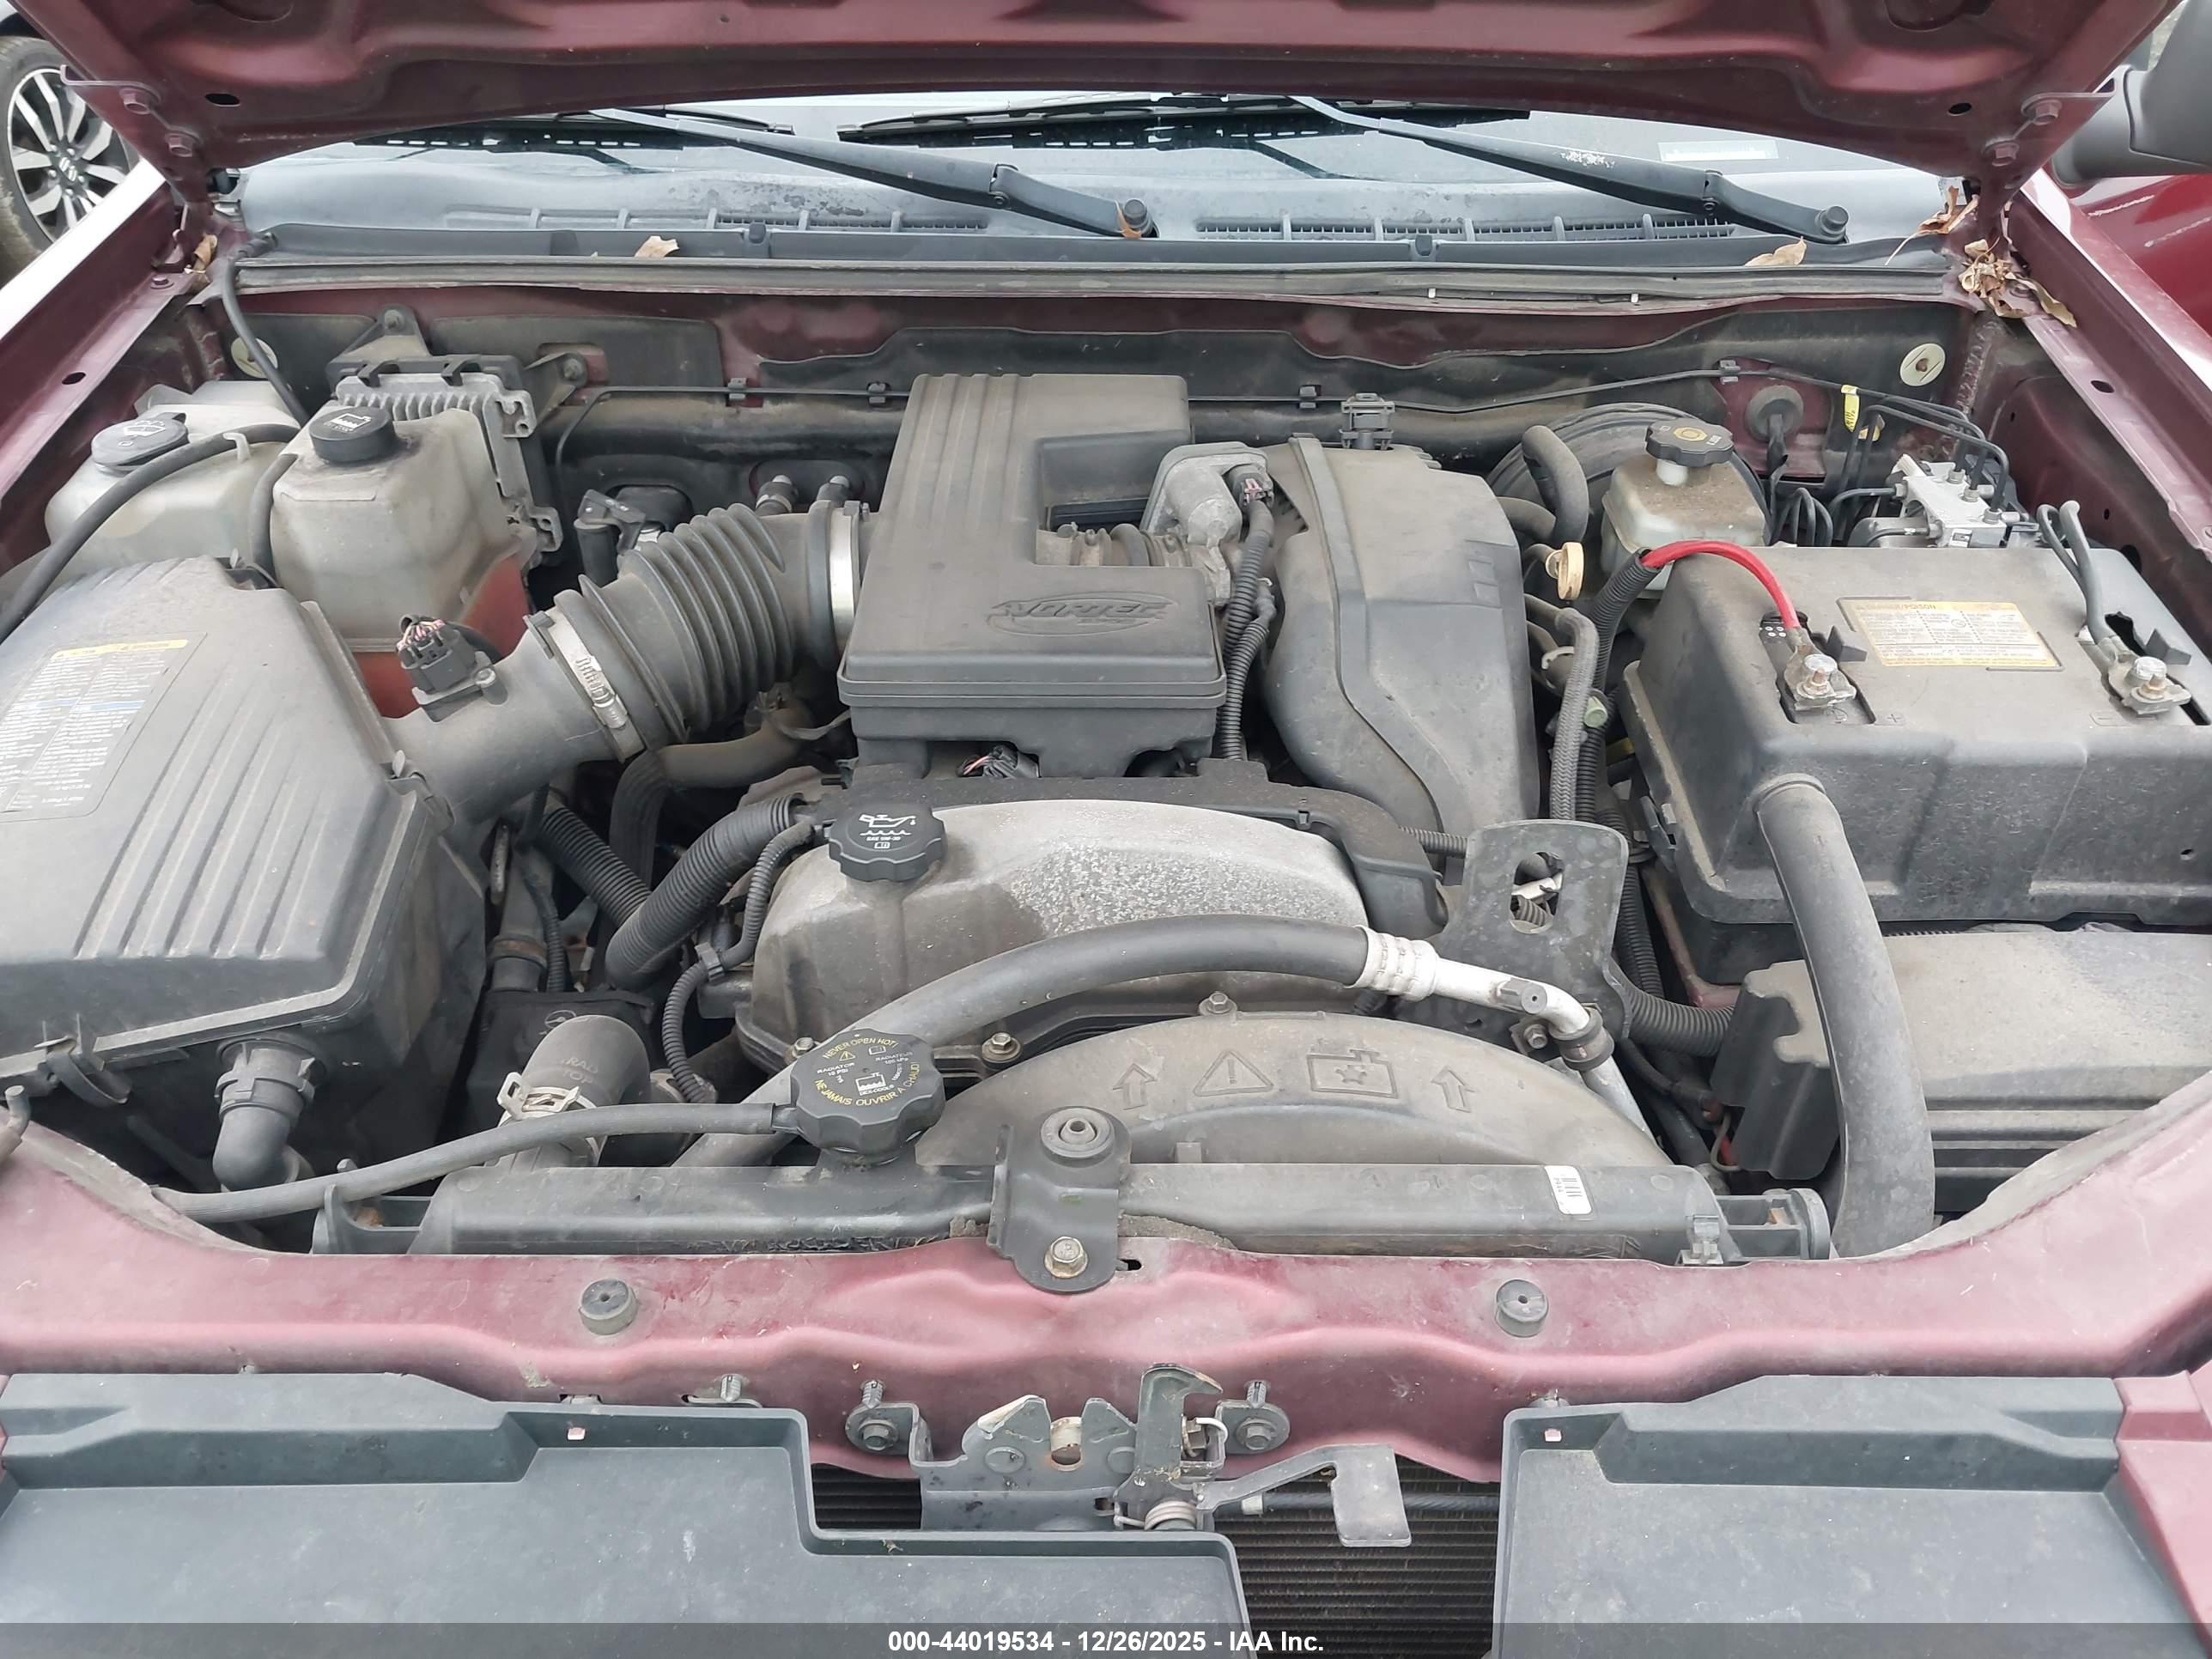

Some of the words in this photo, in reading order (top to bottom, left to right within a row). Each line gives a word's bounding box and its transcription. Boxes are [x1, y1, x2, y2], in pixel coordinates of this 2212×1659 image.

[823, 1042, 851, 1059] NEVER
[878, 1038, 899, 1048] HOT!
[875, 1052, 914, 1061] RADIATEUR
[817, 1062, 855, 1074] RADIATOR
[814, 1079, 828, 1091] NE
[821, 1087, 853, 1106] JAMAIS
[855, 1091, 899, 1107] OUVRIR
